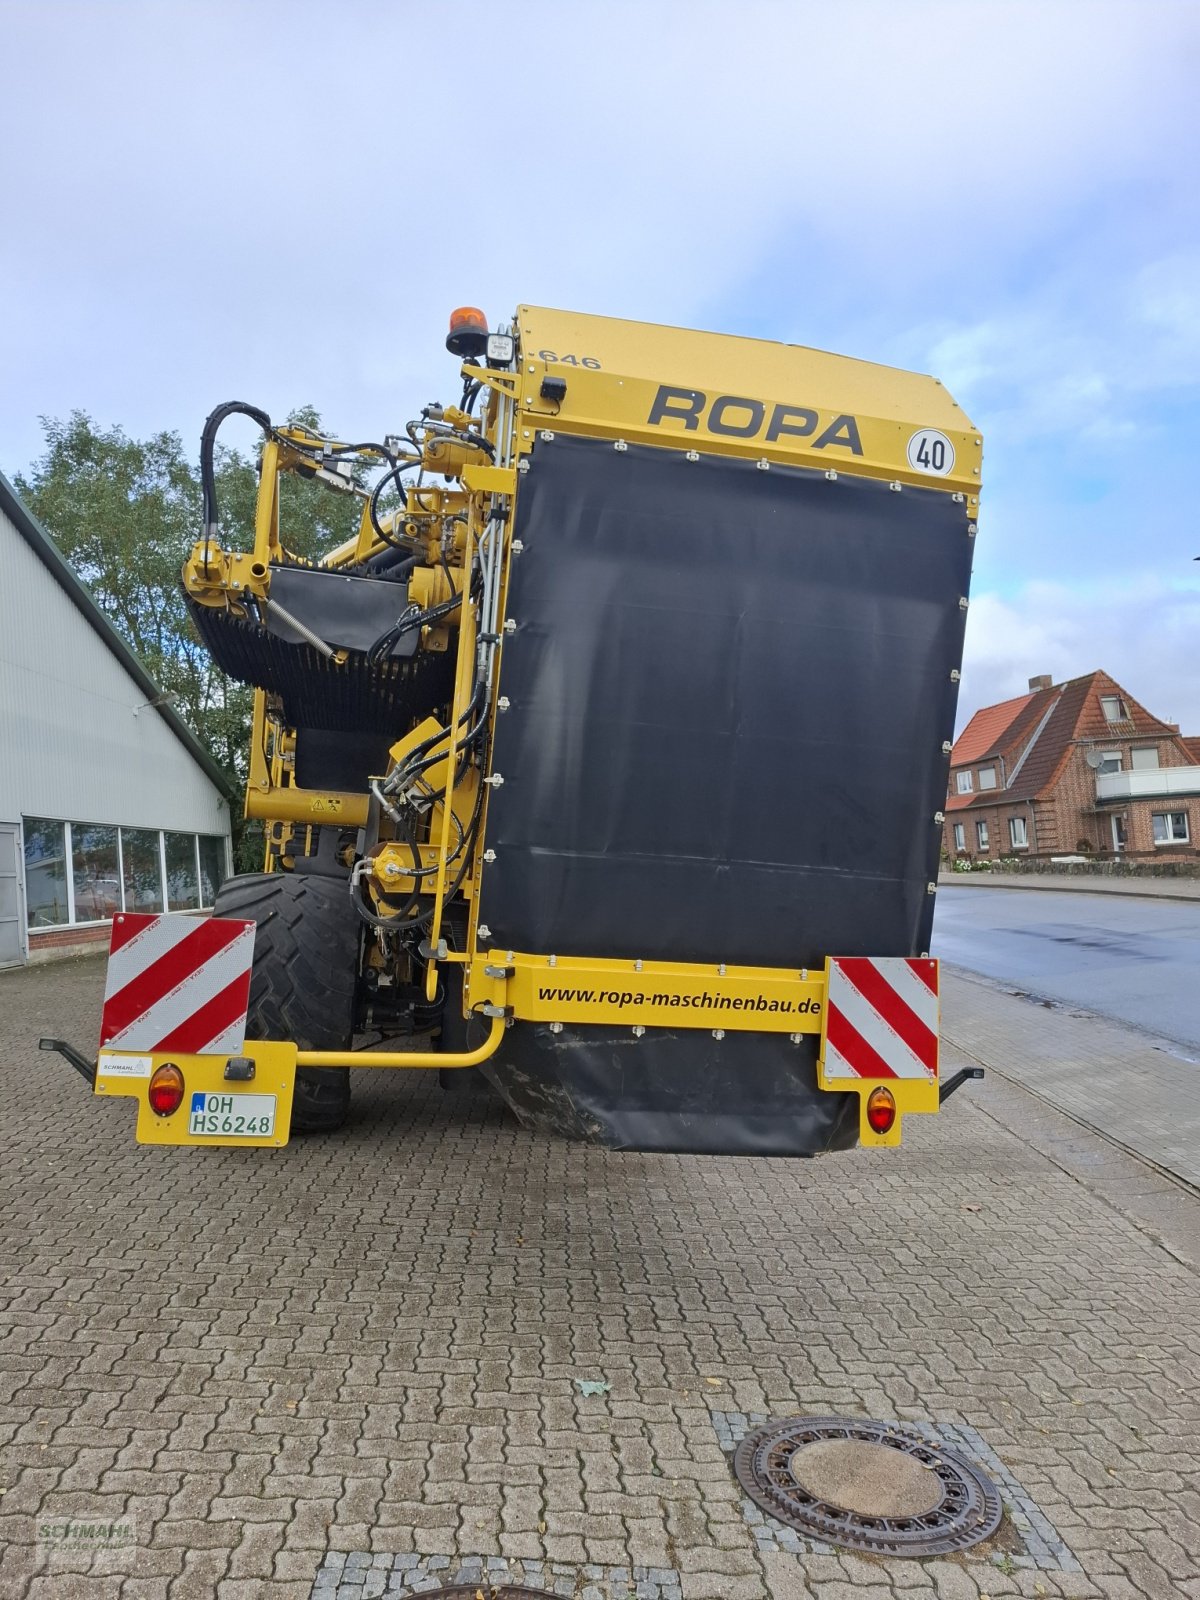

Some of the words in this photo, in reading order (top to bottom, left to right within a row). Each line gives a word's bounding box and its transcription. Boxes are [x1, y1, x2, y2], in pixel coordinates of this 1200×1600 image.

[538, 350, 602, 370] 646
[647, 384, 864, 457] ROPA
[915, 436, 946, 472] 40
[538, 986, 821, 1015] www.ropa-maschinenbau.de
[207, 1096, 233, 1114] OH
[193, 1115, 270, 1134] HS6248
